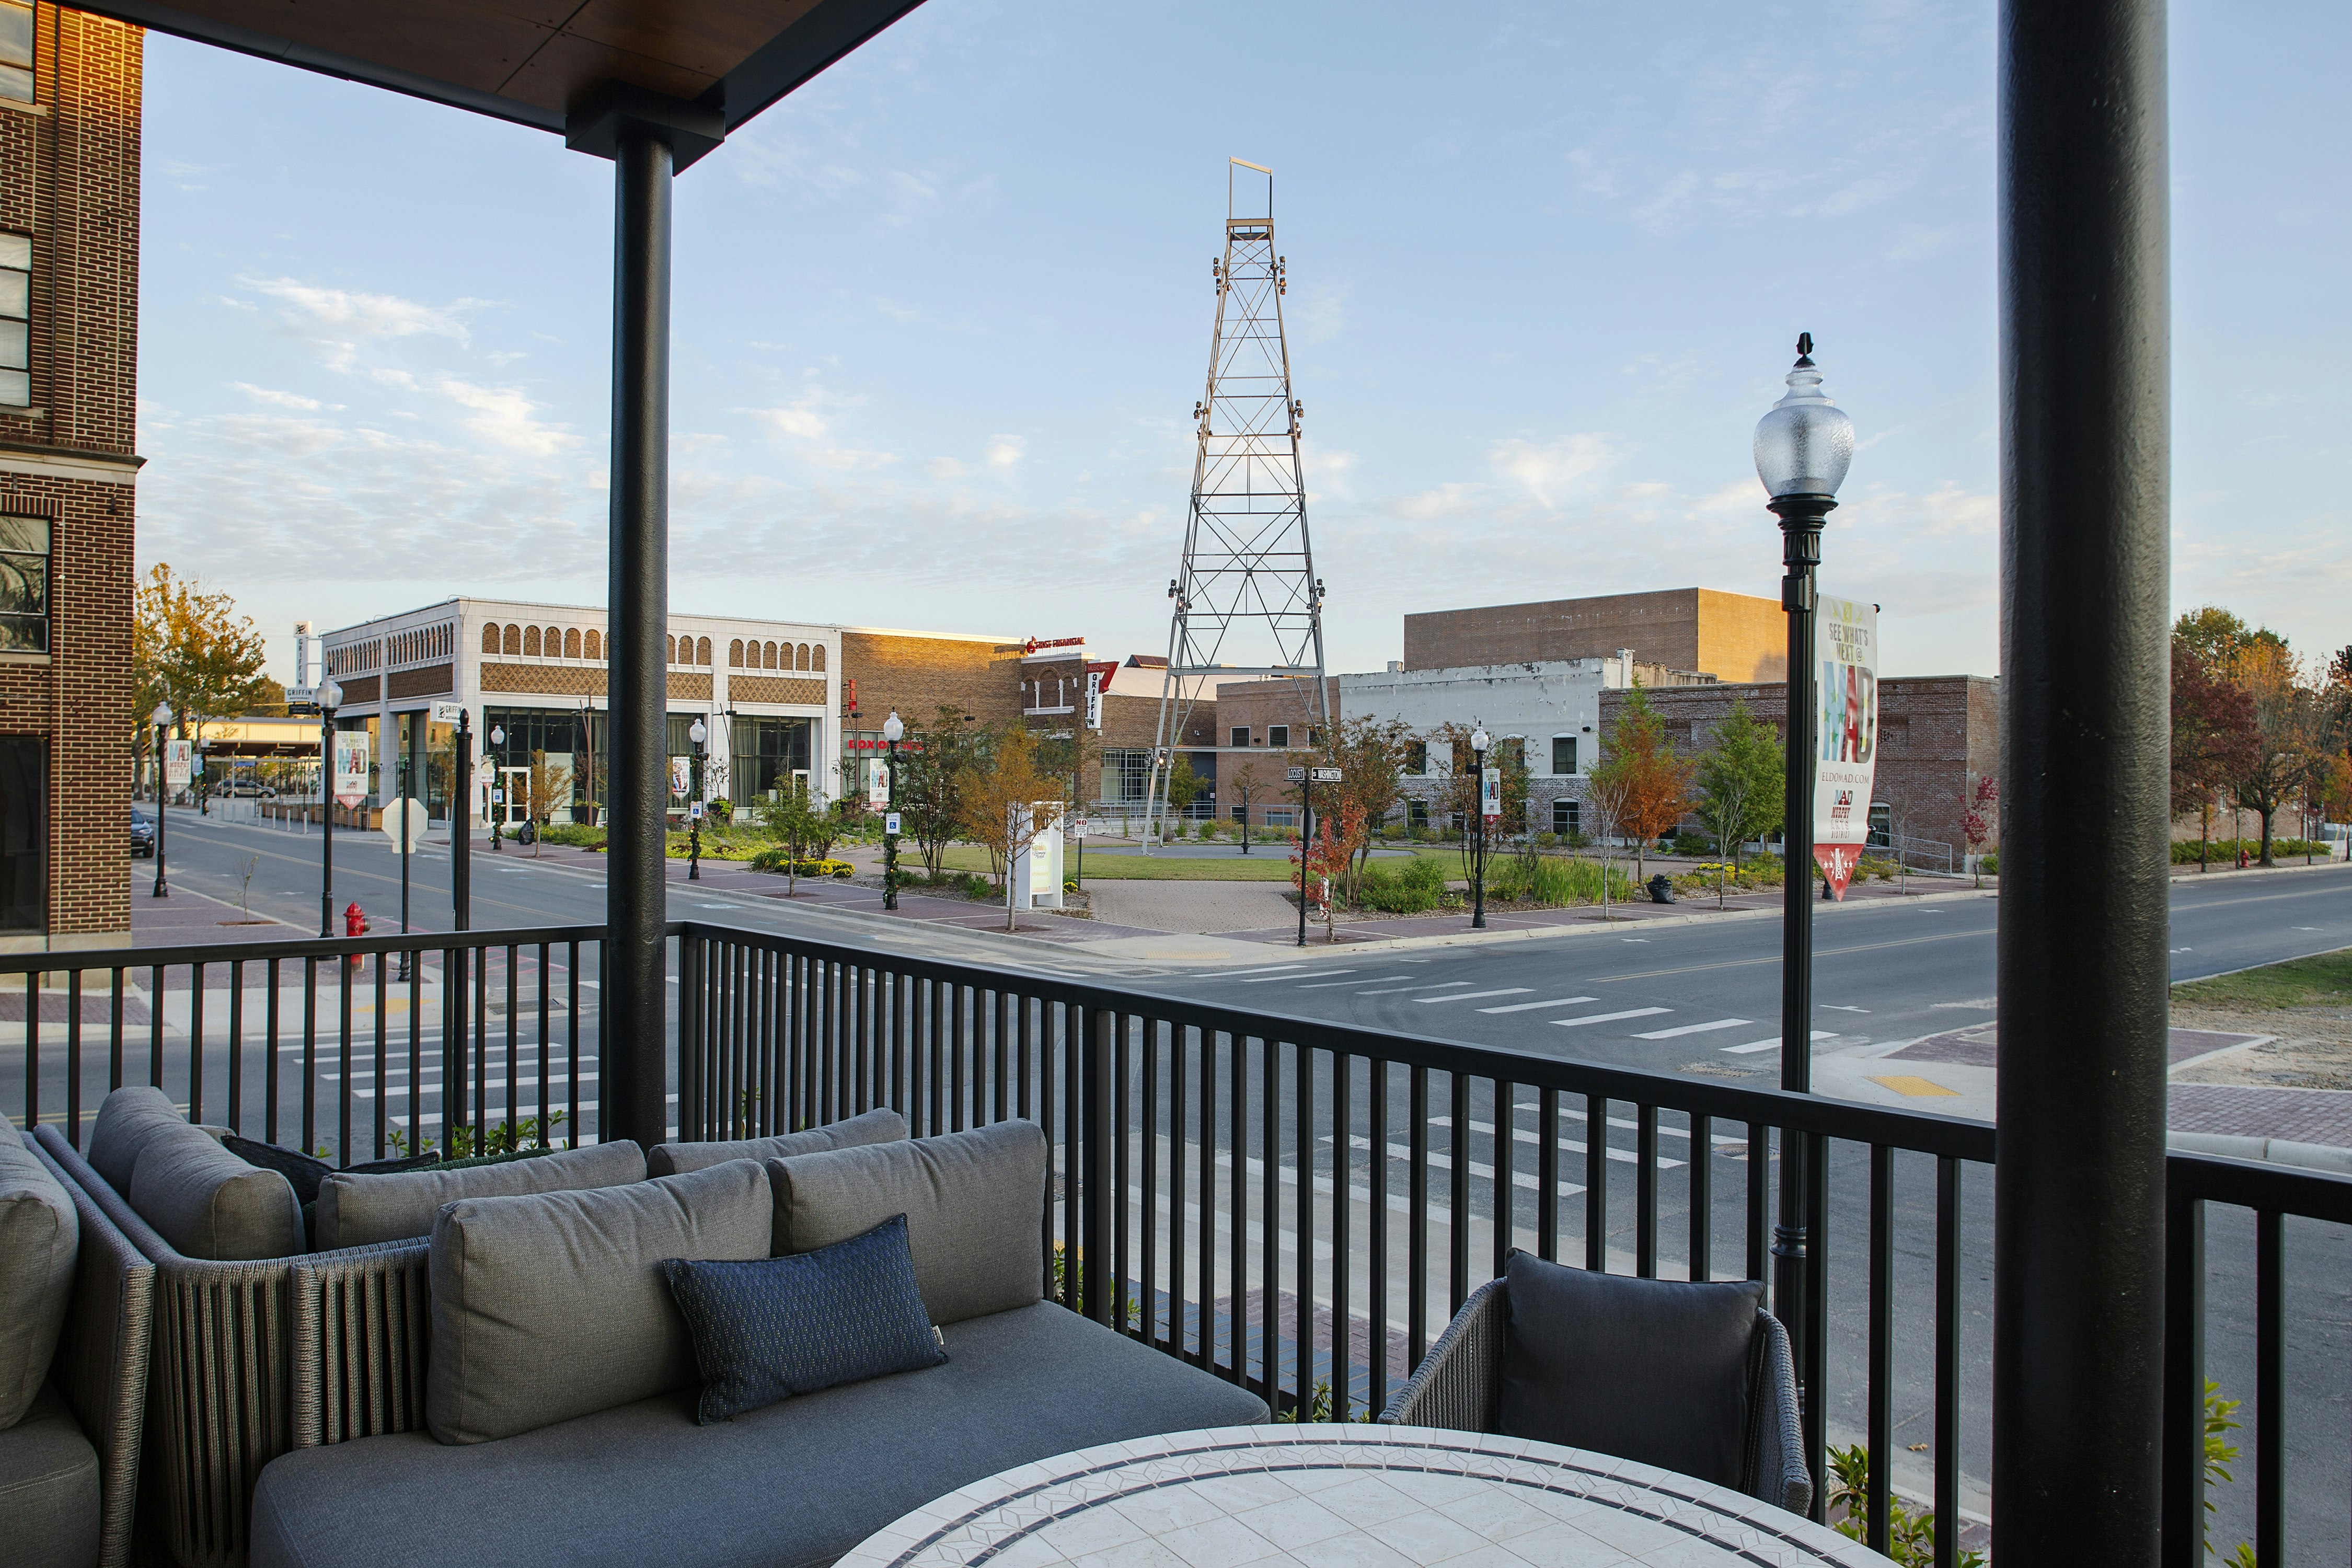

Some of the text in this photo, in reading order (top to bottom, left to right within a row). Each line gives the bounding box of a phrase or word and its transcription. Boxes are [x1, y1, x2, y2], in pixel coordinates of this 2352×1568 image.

[1829, 622, 1868, 647] SEE WHAT'S
[1053, 637, 1086, 647] FINANCIAL
[1836, 642, 1862, 662] NEXT @
[1089, 674, 1097, 725] GRIFFIN
[446, 705, 462, 713] GRIFFIN
[1822, 661, 1874, 764] MAD
[848, 740, 875, 749] BOX
[168, 744, 190, 761] MAD
[338, 748, 367, 774] MAD
[871, 770, 888, 788] MAD
[1288, 769, 1303, 778] LOCUST
[1318, 769, 1341, 779] WASHINGTON
[1821, 772, 1870, 784] ELDOMAD.COM
[1484, 781, 1498, 800] MAD
[1834, 789, 1853, 805] MAD
[1831, 806, 1851, 819] MURPHY
[1830, 819, 1849, 830] ARTS
[1831, 831, 1850, 839] DISTRICT
